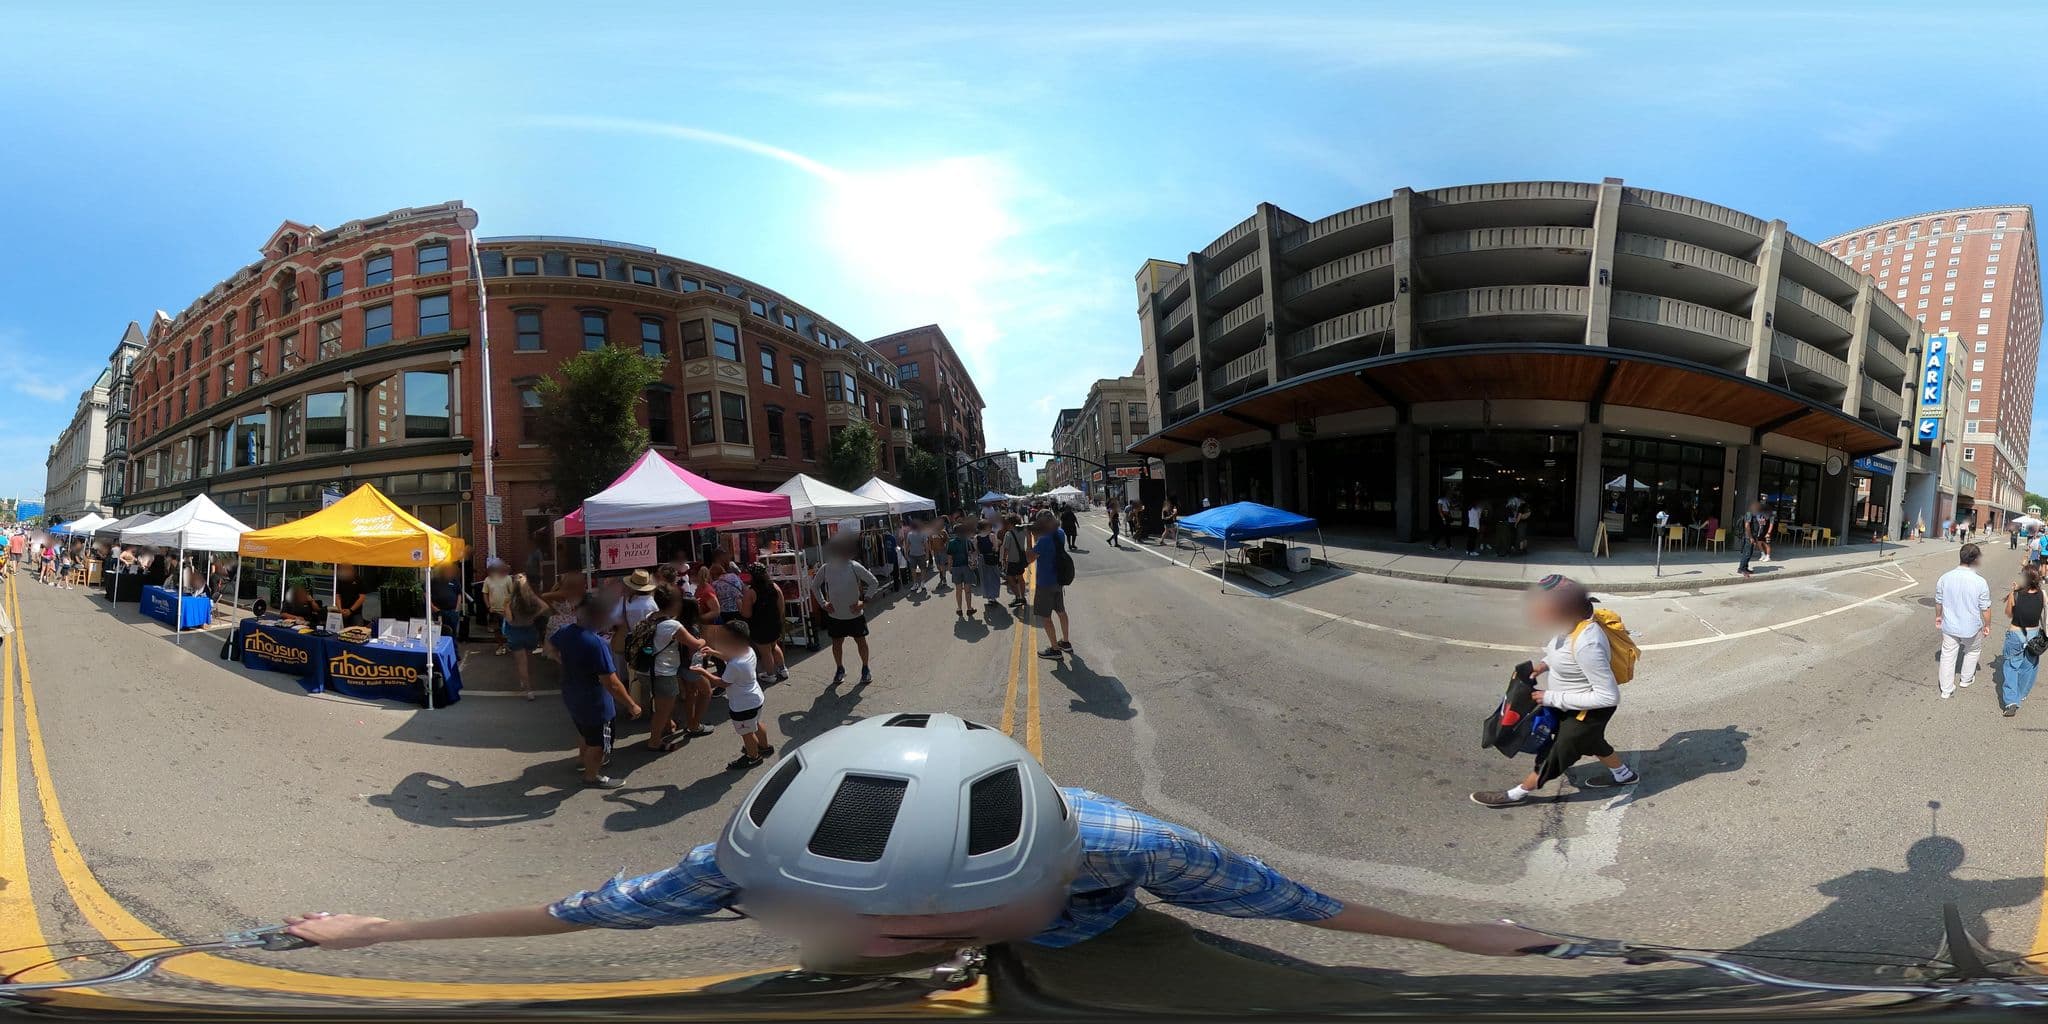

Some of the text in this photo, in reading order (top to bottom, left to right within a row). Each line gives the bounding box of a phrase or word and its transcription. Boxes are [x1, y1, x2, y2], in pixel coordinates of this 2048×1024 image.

[1925, 341, 1942, 400] PARK
[245, 630, 308, 664] rihousing
[330, 651, 417, 683] rihousing
